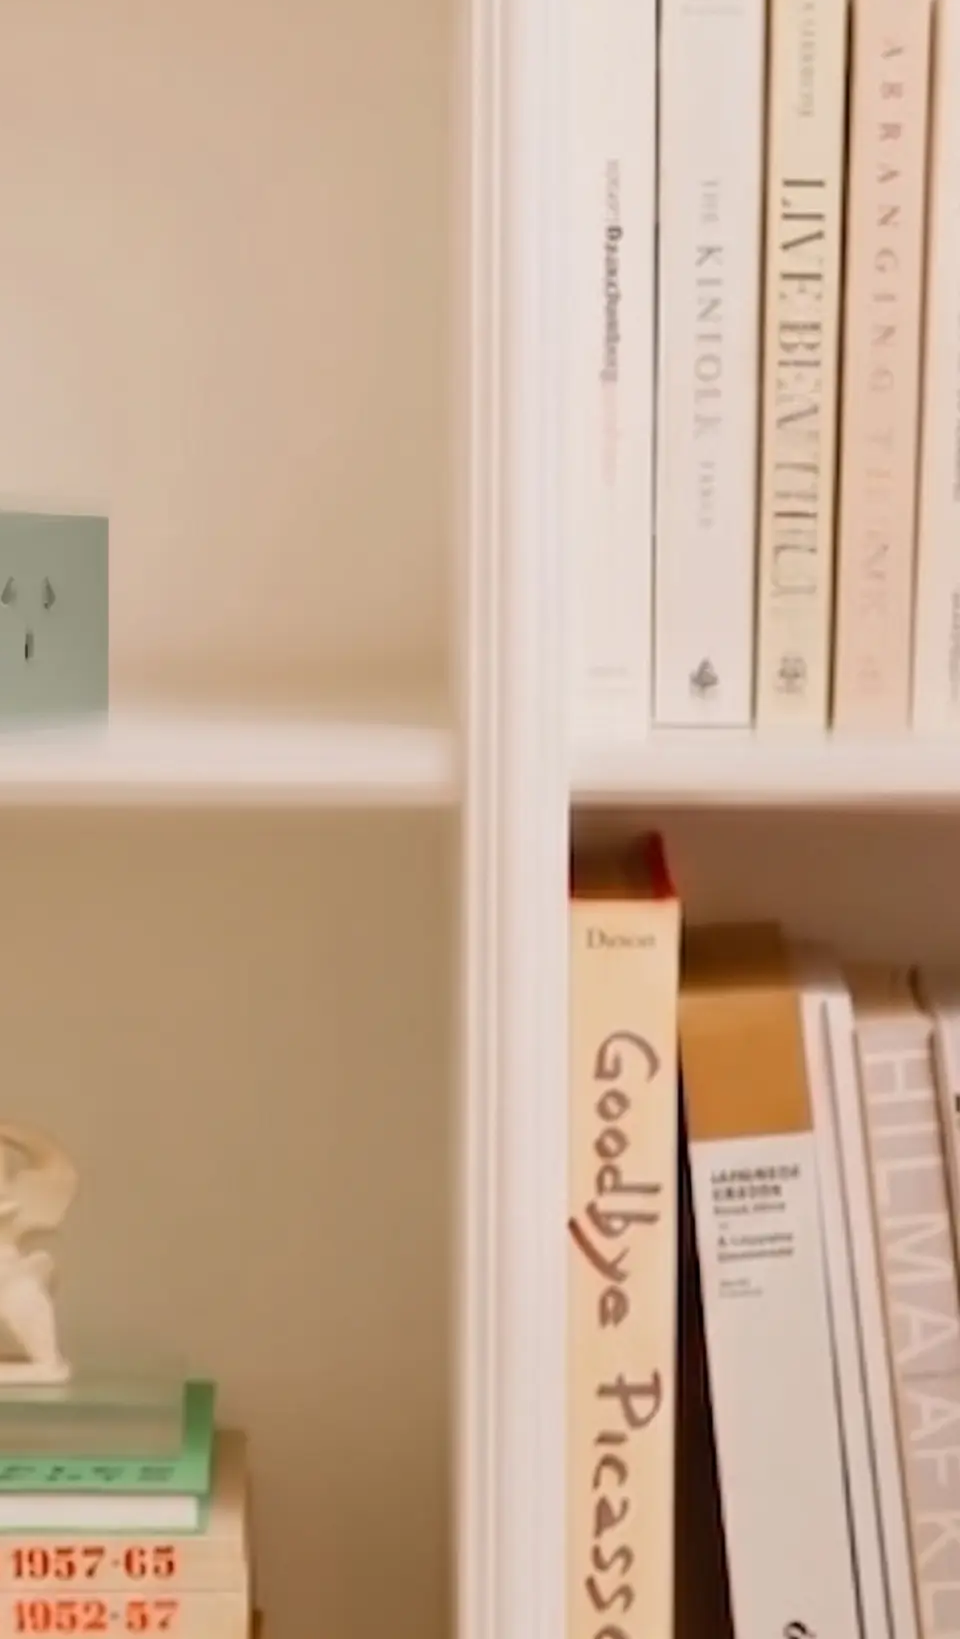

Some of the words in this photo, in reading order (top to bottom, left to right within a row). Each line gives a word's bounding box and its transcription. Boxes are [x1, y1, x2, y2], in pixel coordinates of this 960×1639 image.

[568, 1029, 663, 1330] Goodbye
[862, 1048, 960, 1364] HILMA
[904, 1387, 960, 1488] AF
